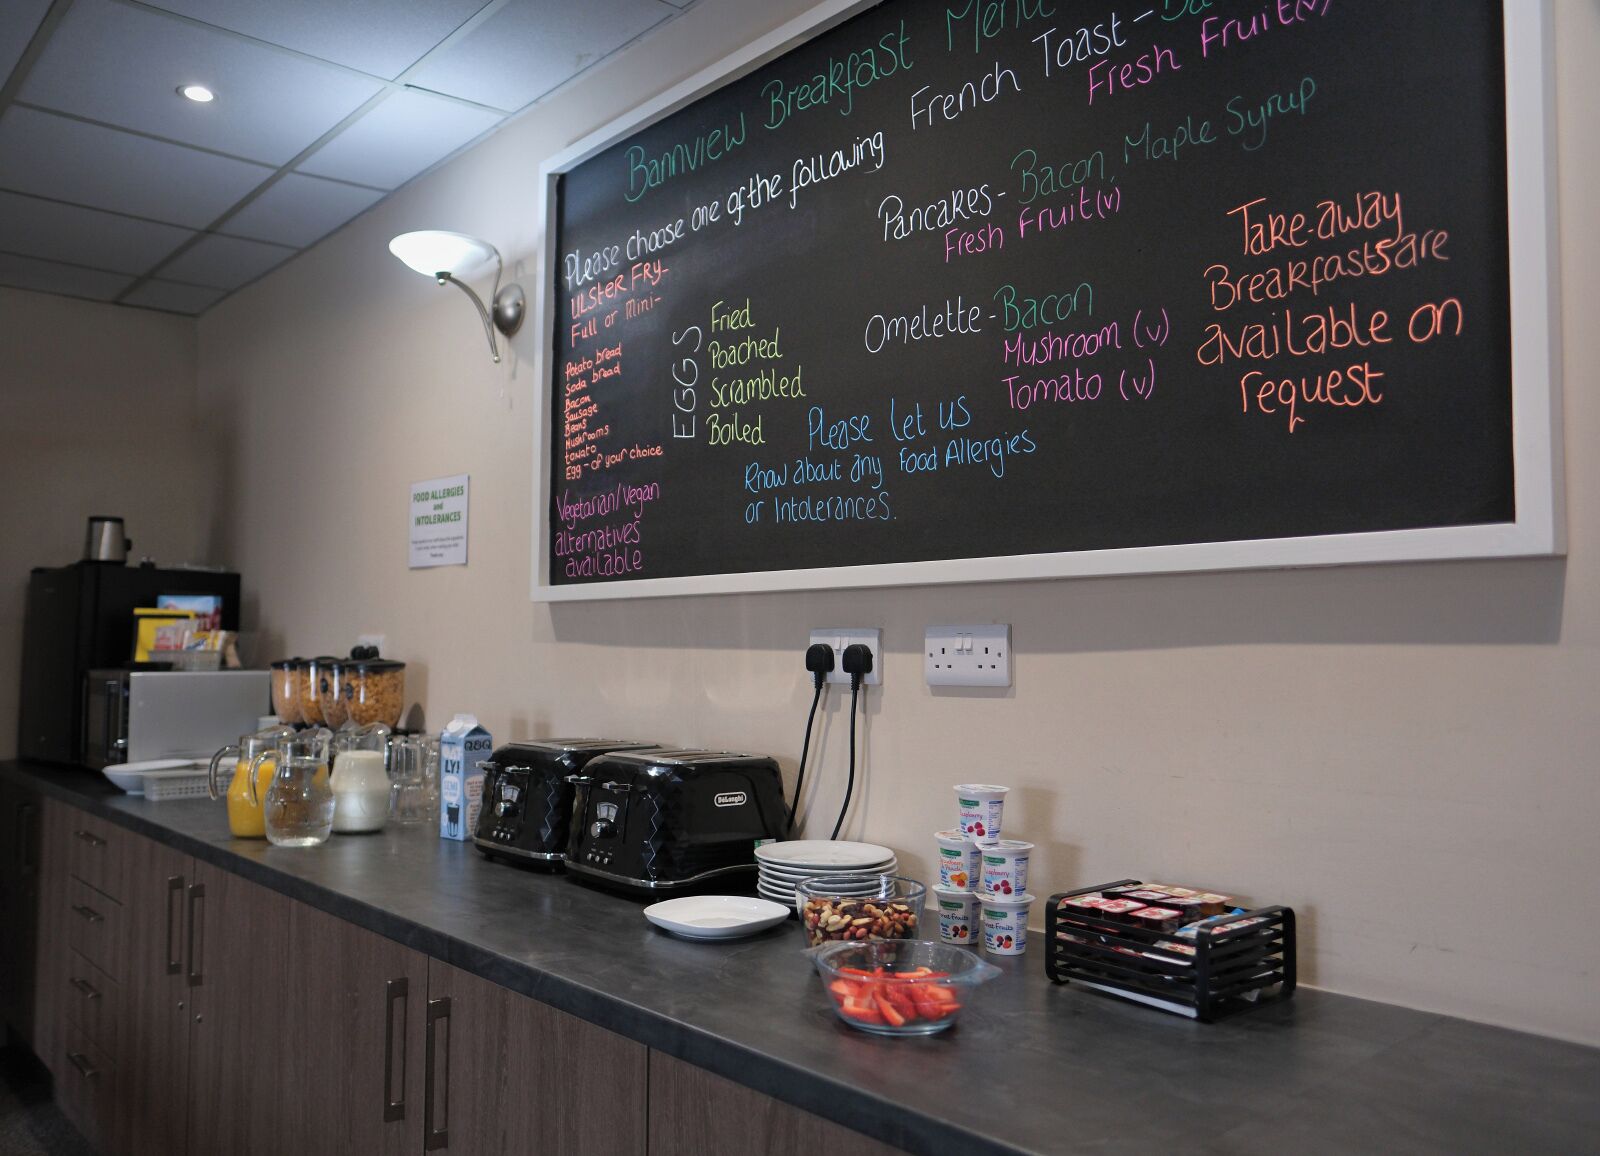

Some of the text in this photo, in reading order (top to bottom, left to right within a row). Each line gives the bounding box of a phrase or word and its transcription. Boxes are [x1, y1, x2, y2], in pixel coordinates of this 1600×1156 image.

[911, 61, 1021, 130] French
[1089, 45, 1181, 105] Fresh
[624, 0, 1056, 202] Bannview Breakfast Menu
[1124, 116, 1217, 165] Maple
[1226, 77, 1316, 152] Syrup
[564, 249, 619, 292] Please
[691, 201, 720, 232] one
[747, 173, 783, 208] the
[789, 131, 885, 210] following
[1226, 191, 1402, 255] Take-away
[945, 223, 1004, 263] Fresh
[1204, 230, 1449, 311] Breakfasts are
[711, 297, 756, 333] Fried
[993, 282, 1093, 331] Bacon
[571, 317, 597, 348] Full
[604, 310, 619, 328] or
[707, 327, 783, 368] Poached
[1004, 321, 1122, 367] Mushroom
[1197, 298, 1462, 365] available on
[595, 343, 622, 365] bread
[565, 361, 622, 397] Soda bread
[672, 326, 702, 438] EGGS
[710, 364, 806, 407] Scrambled
[1001, 367, 1102, 410] Tomato
[1241, 361, 1385, 433] request
[564, 394, 591, 412] Bacon
[565, 403, 598, 423] Sausage
[564, 418, 587, 437] Beans
[706, 412, 766, 445] Boiled
[808, 406, 873, 451] Please
[605, 448, 627, 468] your
[629, 443, 664, 459] choice
[793, 456, 841, 484] about
[850, 454, 882, 489] any
[945, 429, 1036, 478] Allergies
[413, 485, 464, 503] FOOD ALLERGIES
[745, 500, 764, 523] or
[415, 511, 461, 526] INTOLERANCES
[555, 520, 640, 556] alternatives
[565, 546, 643, 577] available
